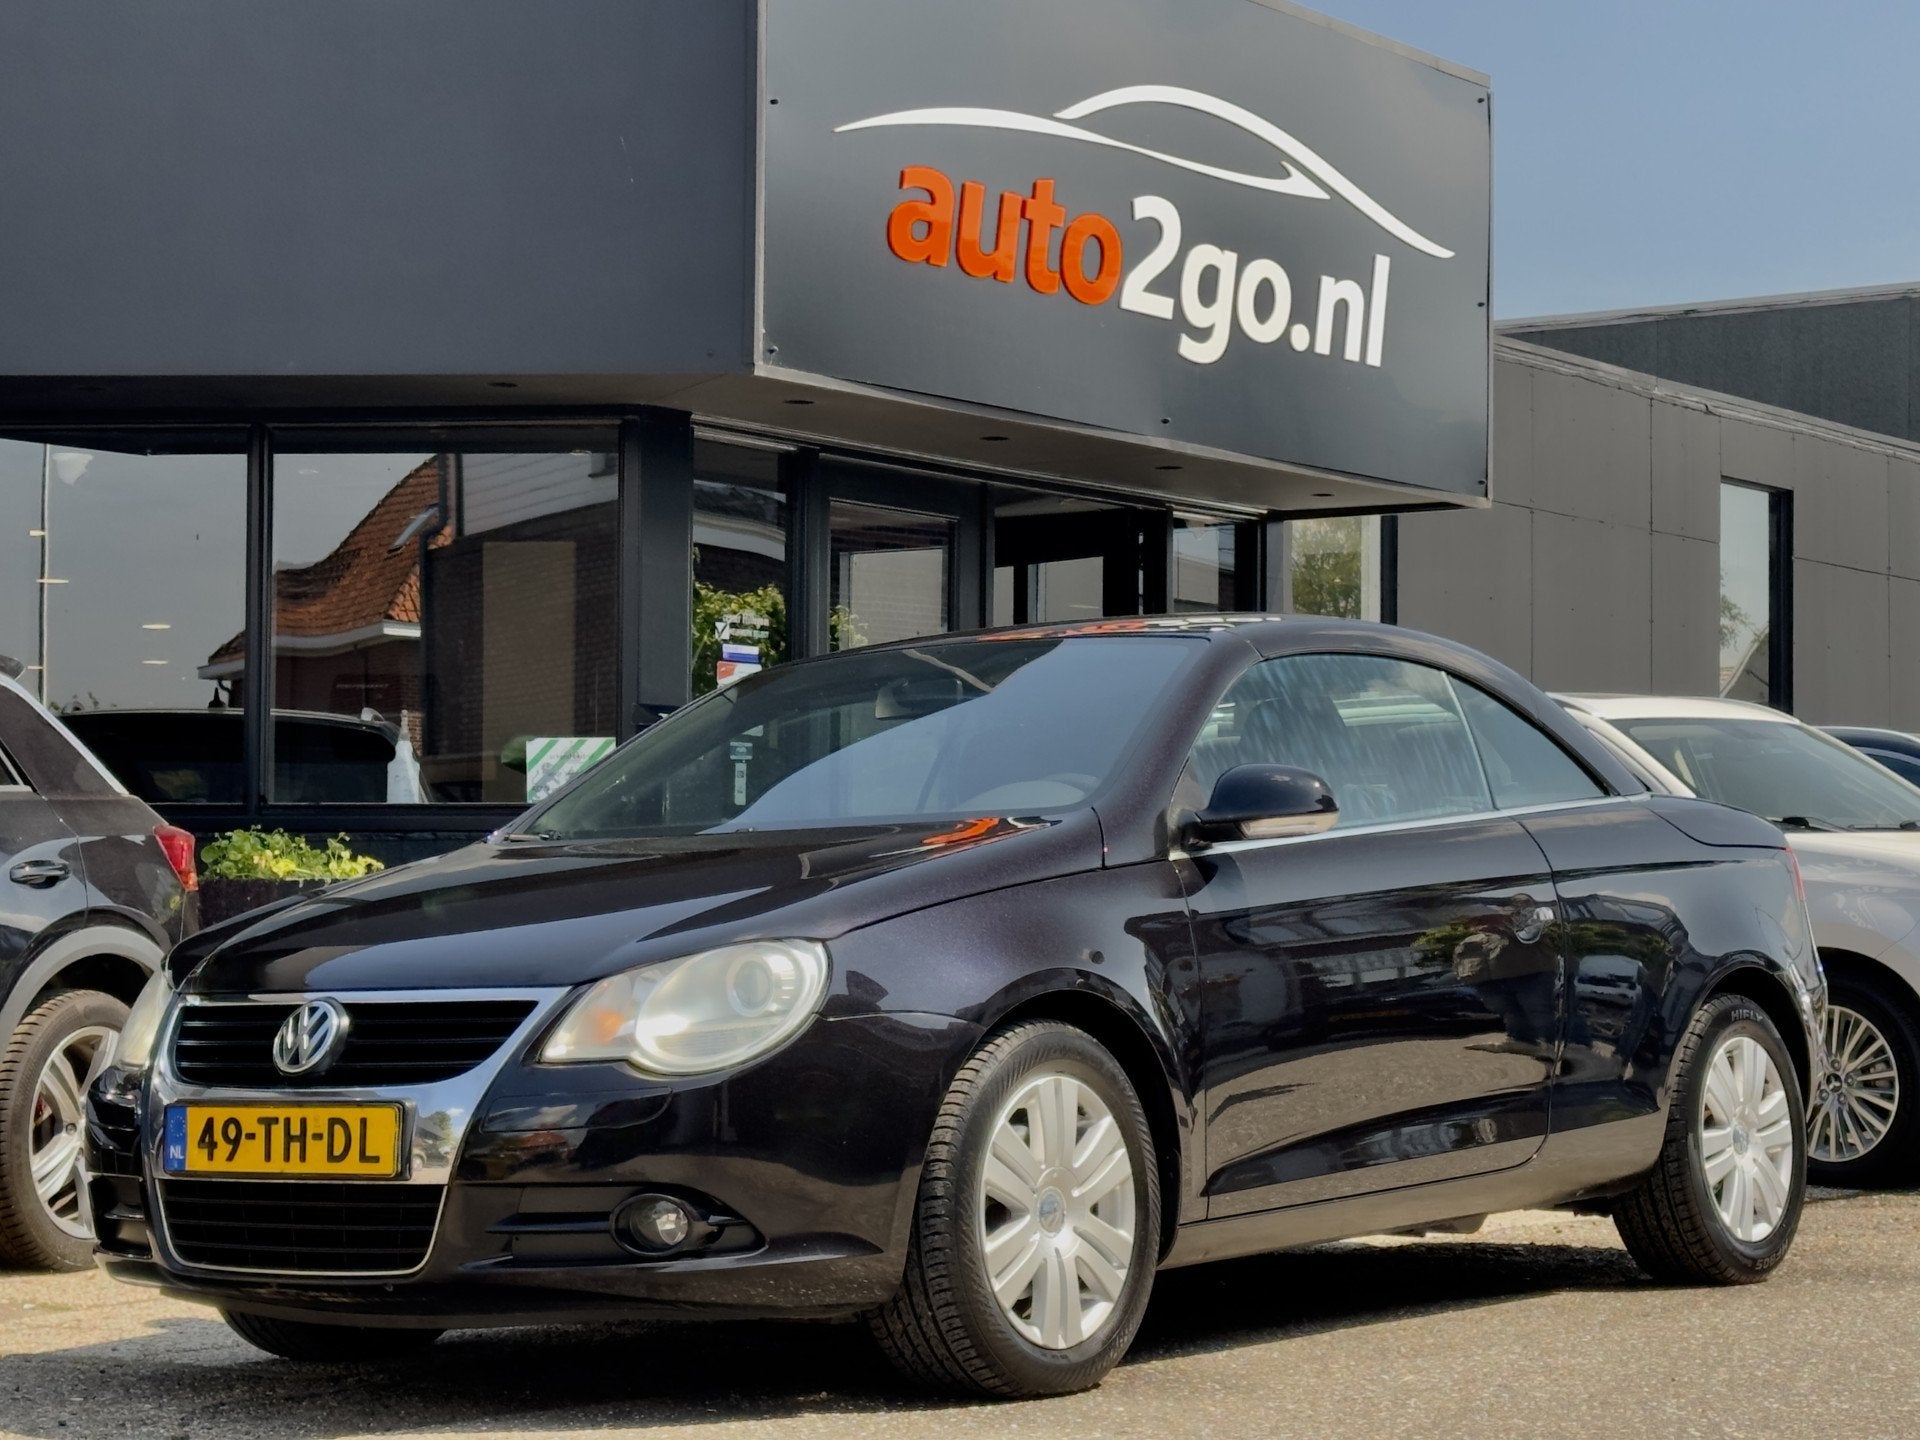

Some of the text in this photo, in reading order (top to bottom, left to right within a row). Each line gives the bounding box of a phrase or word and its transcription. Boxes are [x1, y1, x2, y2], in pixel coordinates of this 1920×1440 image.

[887, 165, 1391, 367] auto2go.nl
[1731, 1009, 1763, 1021] HIFLY
[169, 1144, 185, 1160] NL
[197, 1116, 380, 1163] 49-TH-DL
